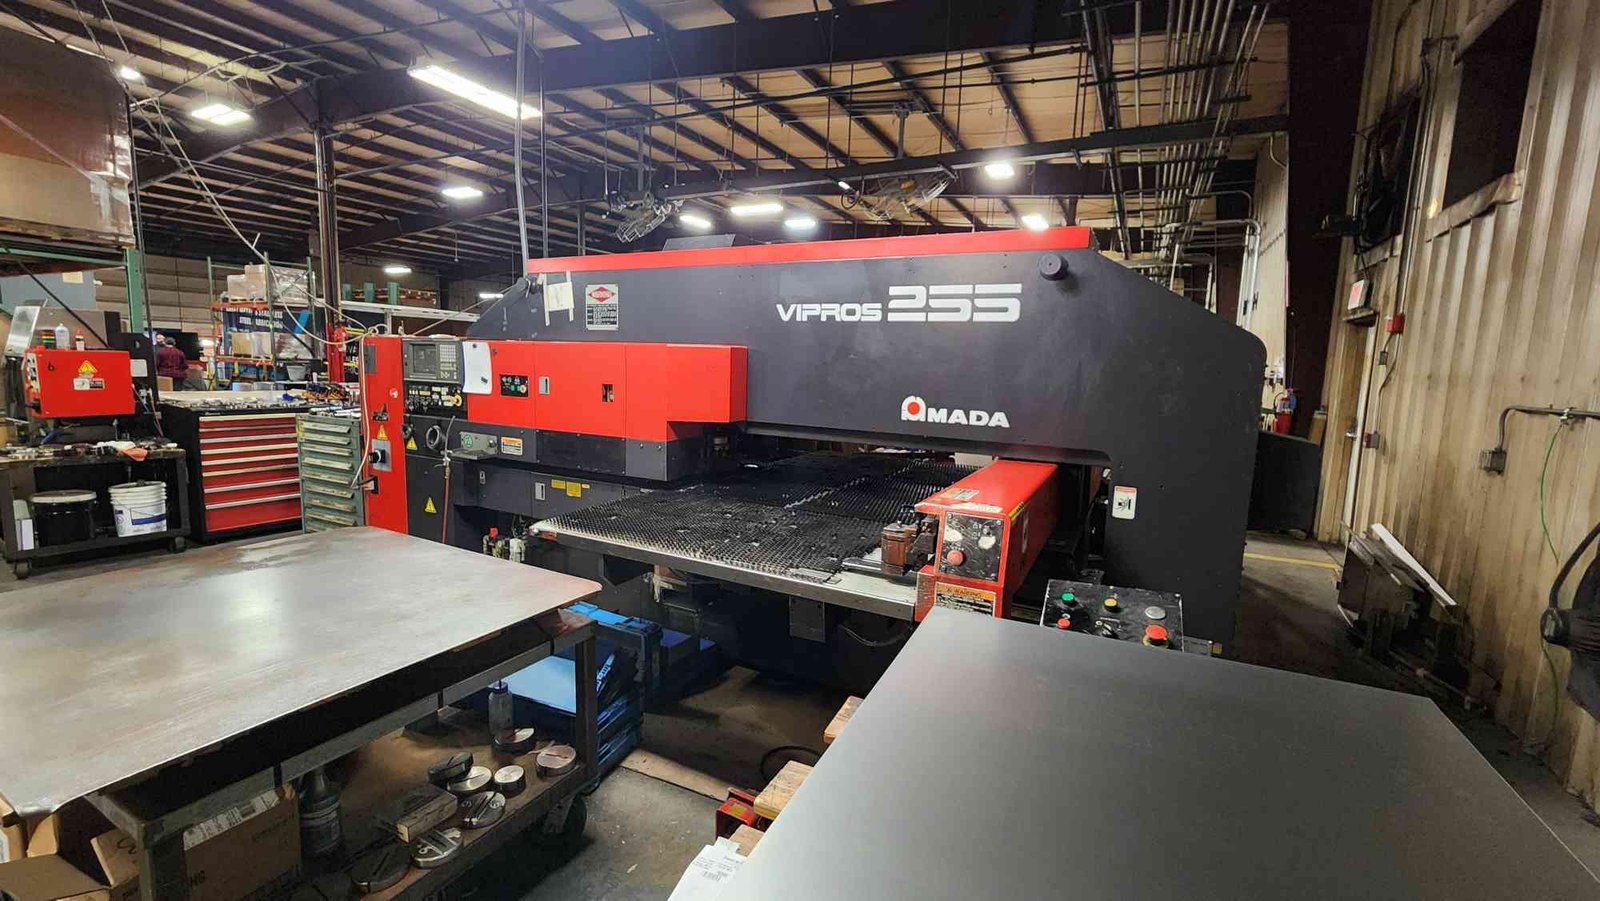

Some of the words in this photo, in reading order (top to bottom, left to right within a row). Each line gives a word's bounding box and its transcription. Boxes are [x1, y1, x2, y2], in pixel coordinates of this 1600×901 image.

[776, 303, 882, 322] VIPROS
[887, 283, 1023, 322] 255
[901, 395, 1010, 428] AMADA
